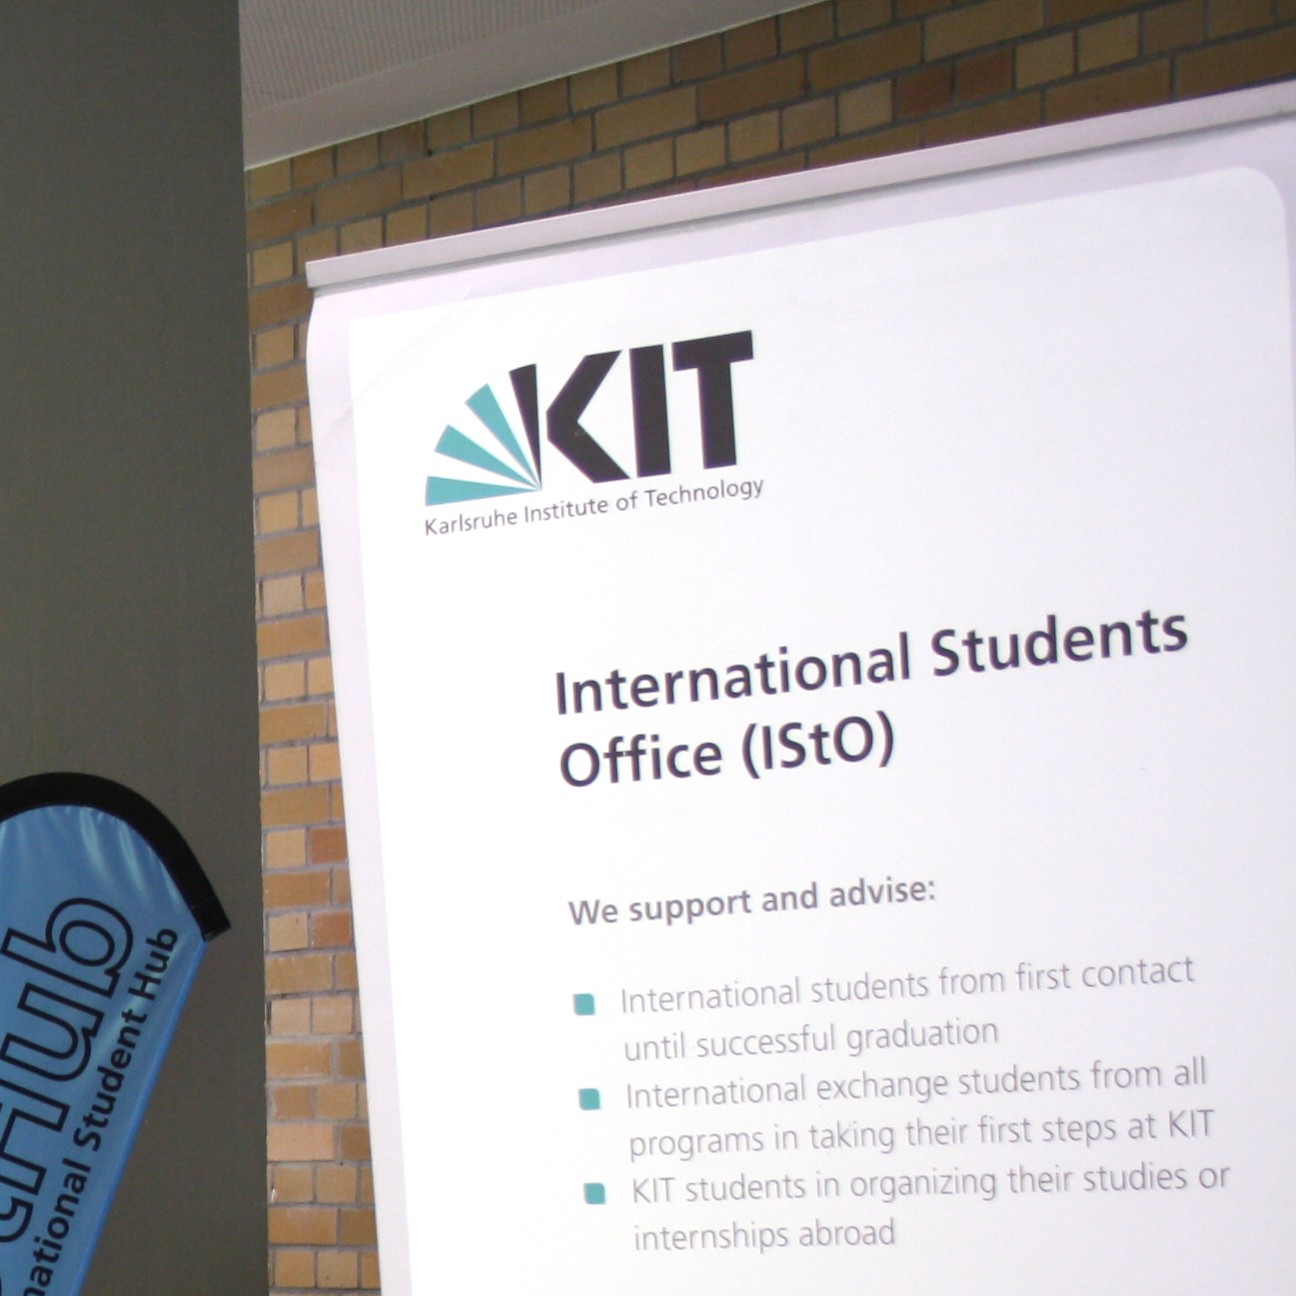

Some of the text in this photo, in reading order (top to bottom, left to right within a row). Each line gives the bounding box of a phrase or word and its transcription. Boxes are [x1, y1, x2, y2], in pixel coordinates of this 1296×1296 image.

[509, 329, 754, 486] KIT
[425, 478, 765, 536] Karlsruhe Institute of Technology
[555, 607, 1189, 716] International Students
[559, 709, 897, 788] Office (IStO)
[568, 874, 937, 926] We support and advise:
[621, 955, 1196, 1015] International students from first contact
[74, 1006, 148, 1152] Student
[127, 926, 179, 1003] Hub
[624, 1016, 1000, 1062] until successful graduation
[626, 1055, 1208, 1110] International exchange students from all
[629, 1107, 1216, 1163] programs in taking their first steps at KIT
[631, 1160, 1231, 1205] KIT students in organizing their studies or
[634, 1217, 897, 1255] internships abroad
